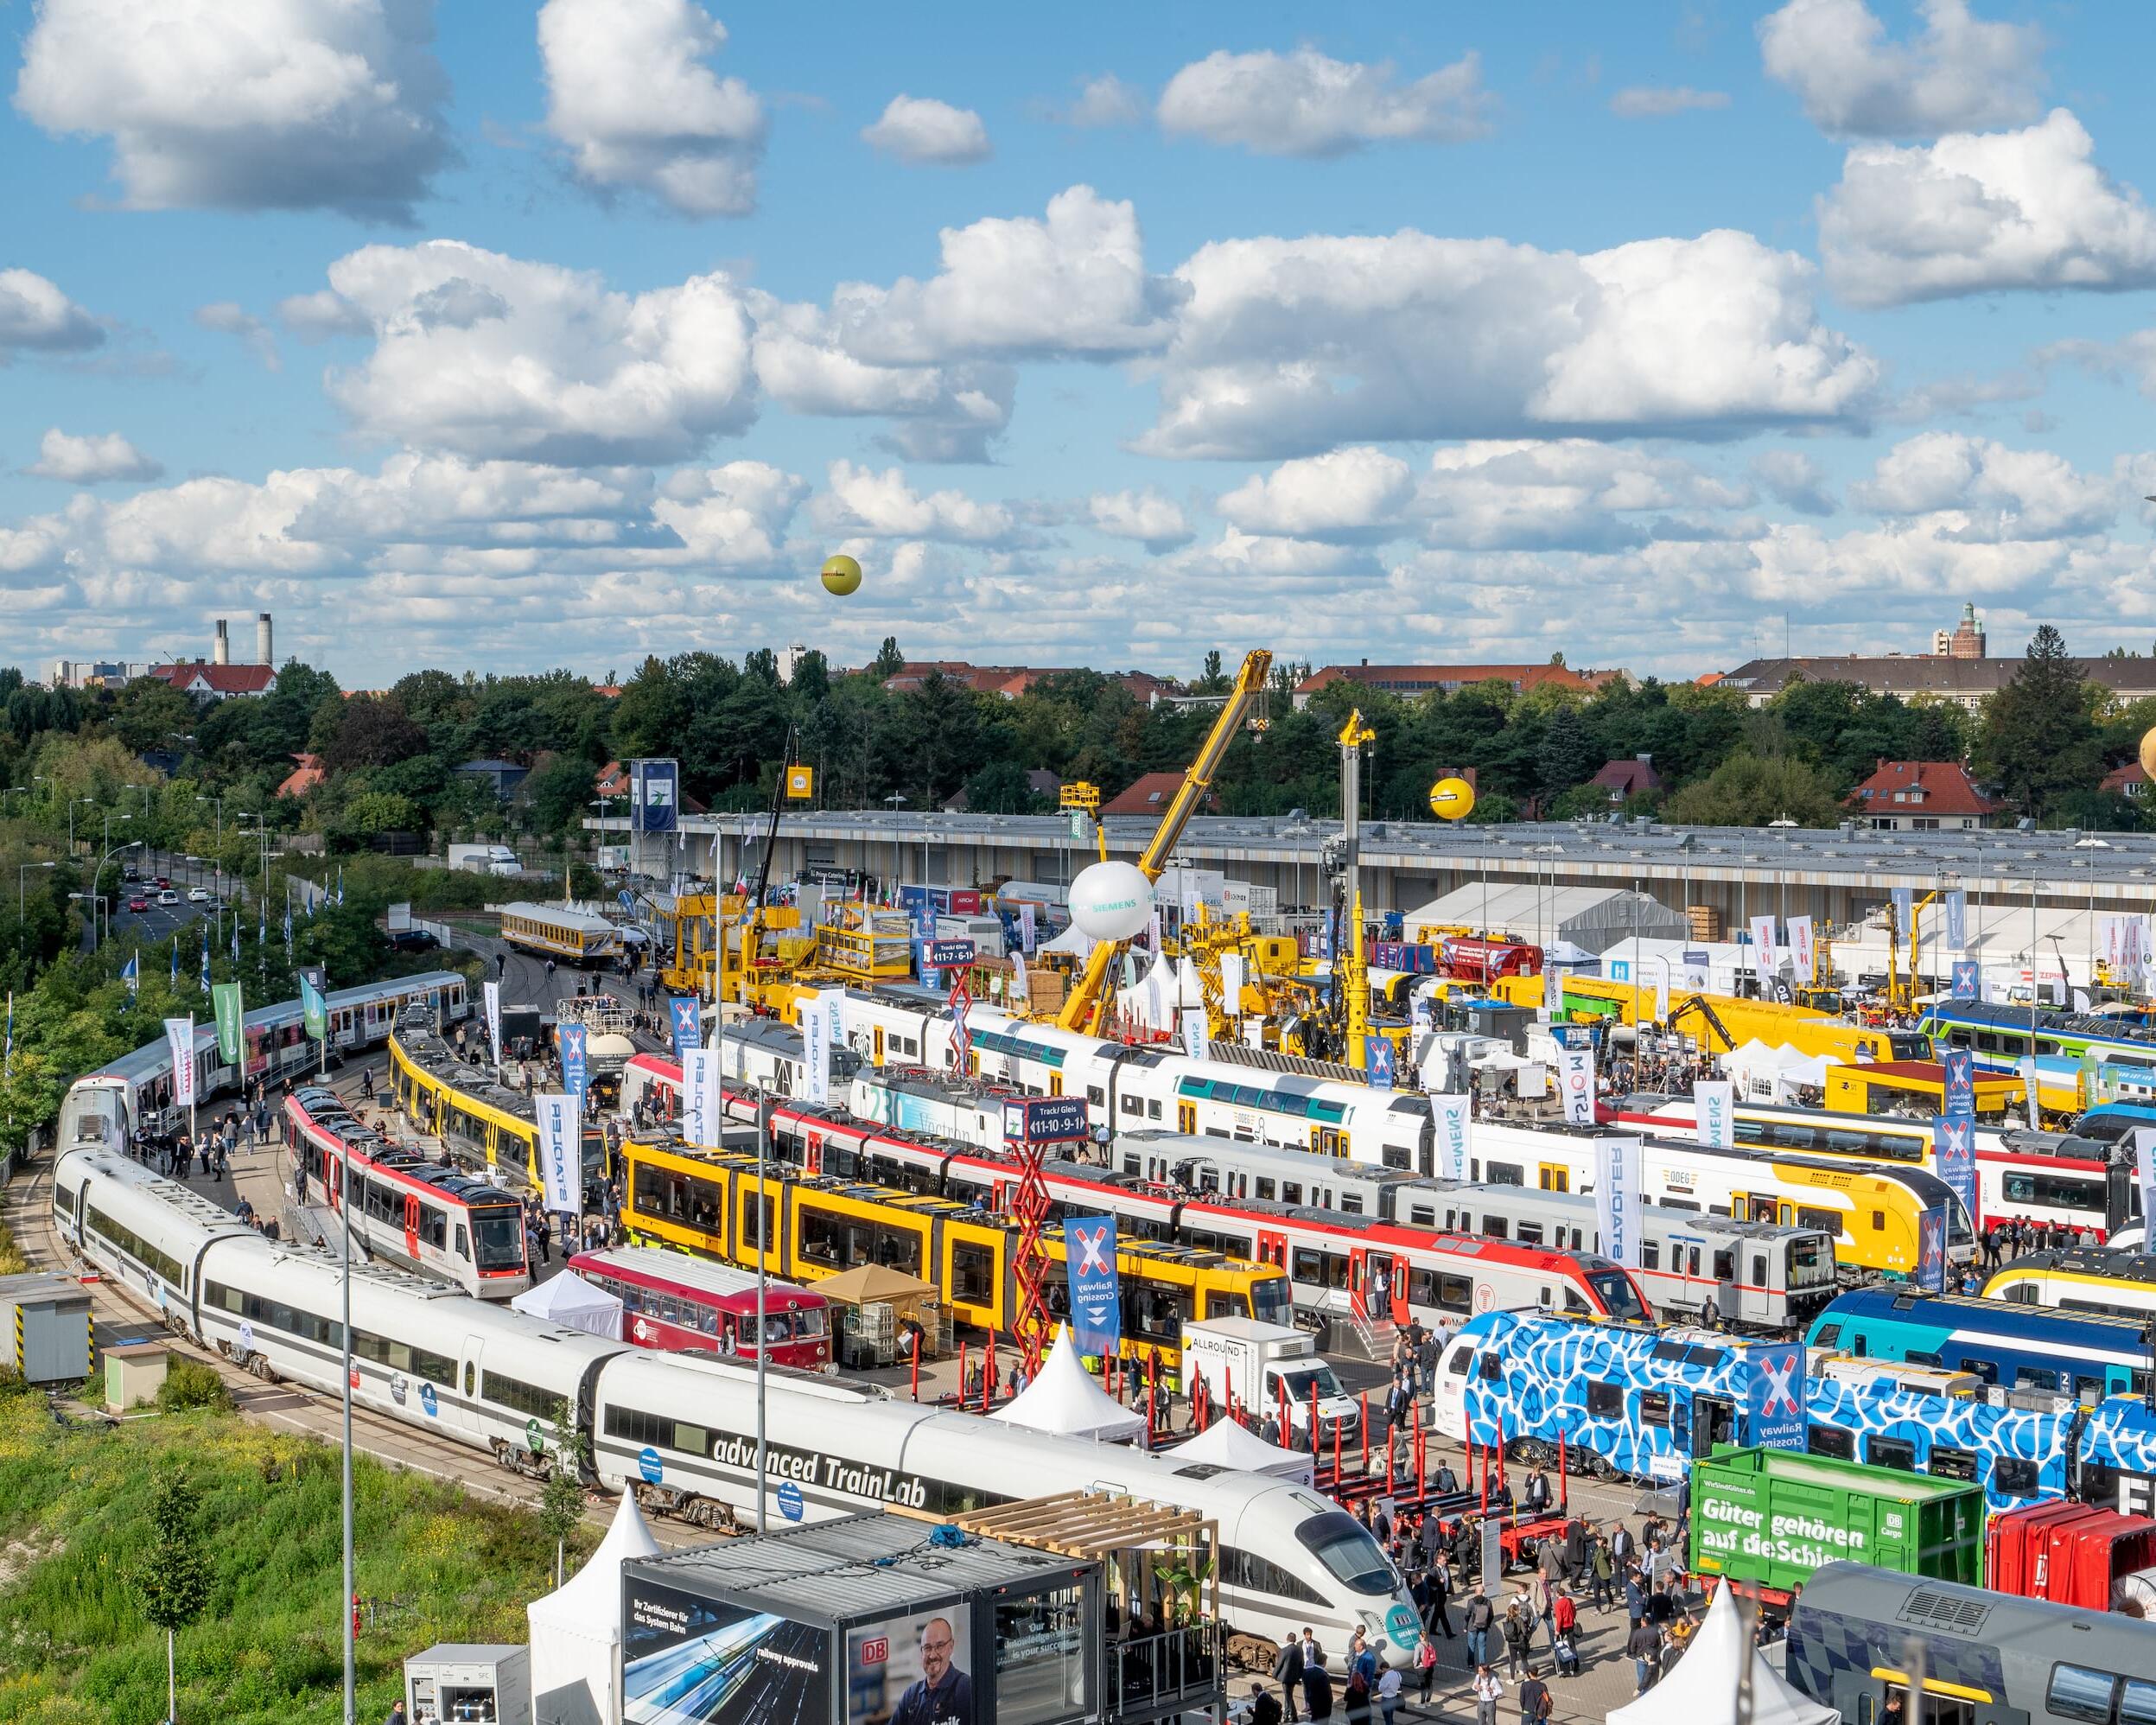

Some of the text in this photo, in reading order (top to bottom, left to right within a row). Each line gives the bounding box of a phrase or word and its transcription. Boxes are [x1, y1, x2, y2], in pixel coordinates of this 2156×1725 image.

[1092, 899, 1136, 913] SIEMENS
[938, 951, 970, 961] 11-7 6-1
[1040, 1105, 1077, 1116] Track/ Gleis
[919, 1112, 970, 1143] Vectron
[1035, 1117, 1079, 1134] 11-10 9-1
[1670, 1171, 1690, 1184] ODEG
[1193, 1338, 1239, 1357] ALLROUND
[2062, 1374, 2069, 1384] 2
[825, 1457, 925, 1508] TrainLab
[1703, 1498, 1864, 1549] Güter gehören
[1888, 1514, 1901, 1527] DB
[1881, 1527, 1903, 1539] Cargo
[1703, 1530, 1860, 1569] auf die Schie
[634, 1599, 689, 1623] Ihr Zertifizierer für
[634, 1612, 686, 1635] das System Bahn
[757, 1647, 819, 1673] railway approvals
[865, 1641, 887, 1662] DB
[1021, 1646, 1039, 1659] your
